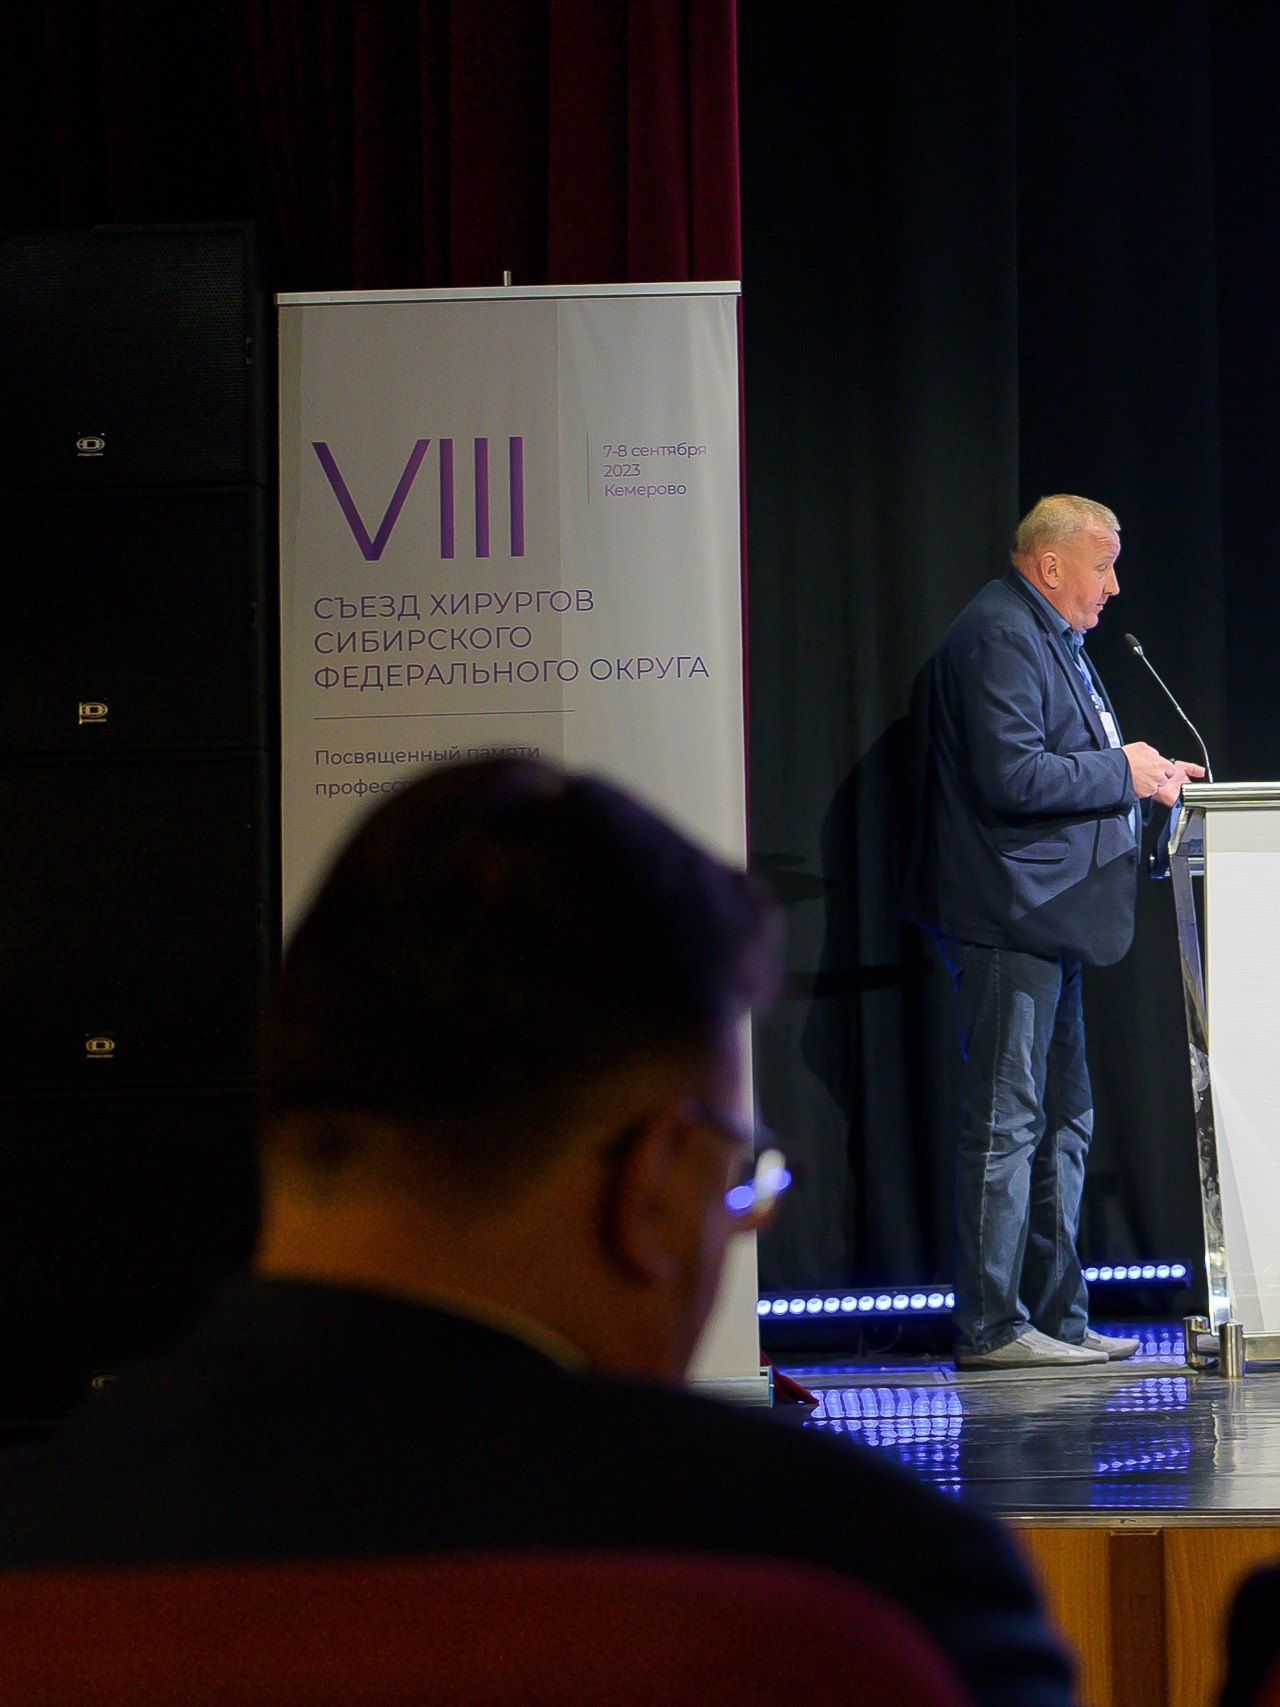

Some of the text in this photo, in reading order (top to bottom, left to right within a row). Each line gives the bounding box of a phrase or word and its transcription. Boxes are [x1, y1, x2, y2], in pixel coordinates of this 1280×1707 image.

[602, 441, 708, 459] 7-8 сентября
[602, 463, 641, 478] 2023
[311, 436, 525, 562] VIII
[603, 483, 688, 499] Кемерово
[313, 589, 595, 622] СЪЕЗД ХИРУРГОВ
[313, 626, 532, 655] СИБИРСКОГО
[313, 656, 711, 693] ФЕДЕРАЛЬНОГО ОКРУГА
[315, 745, 461, 766] Посвященный
[315, 779, 411, 799] професс
